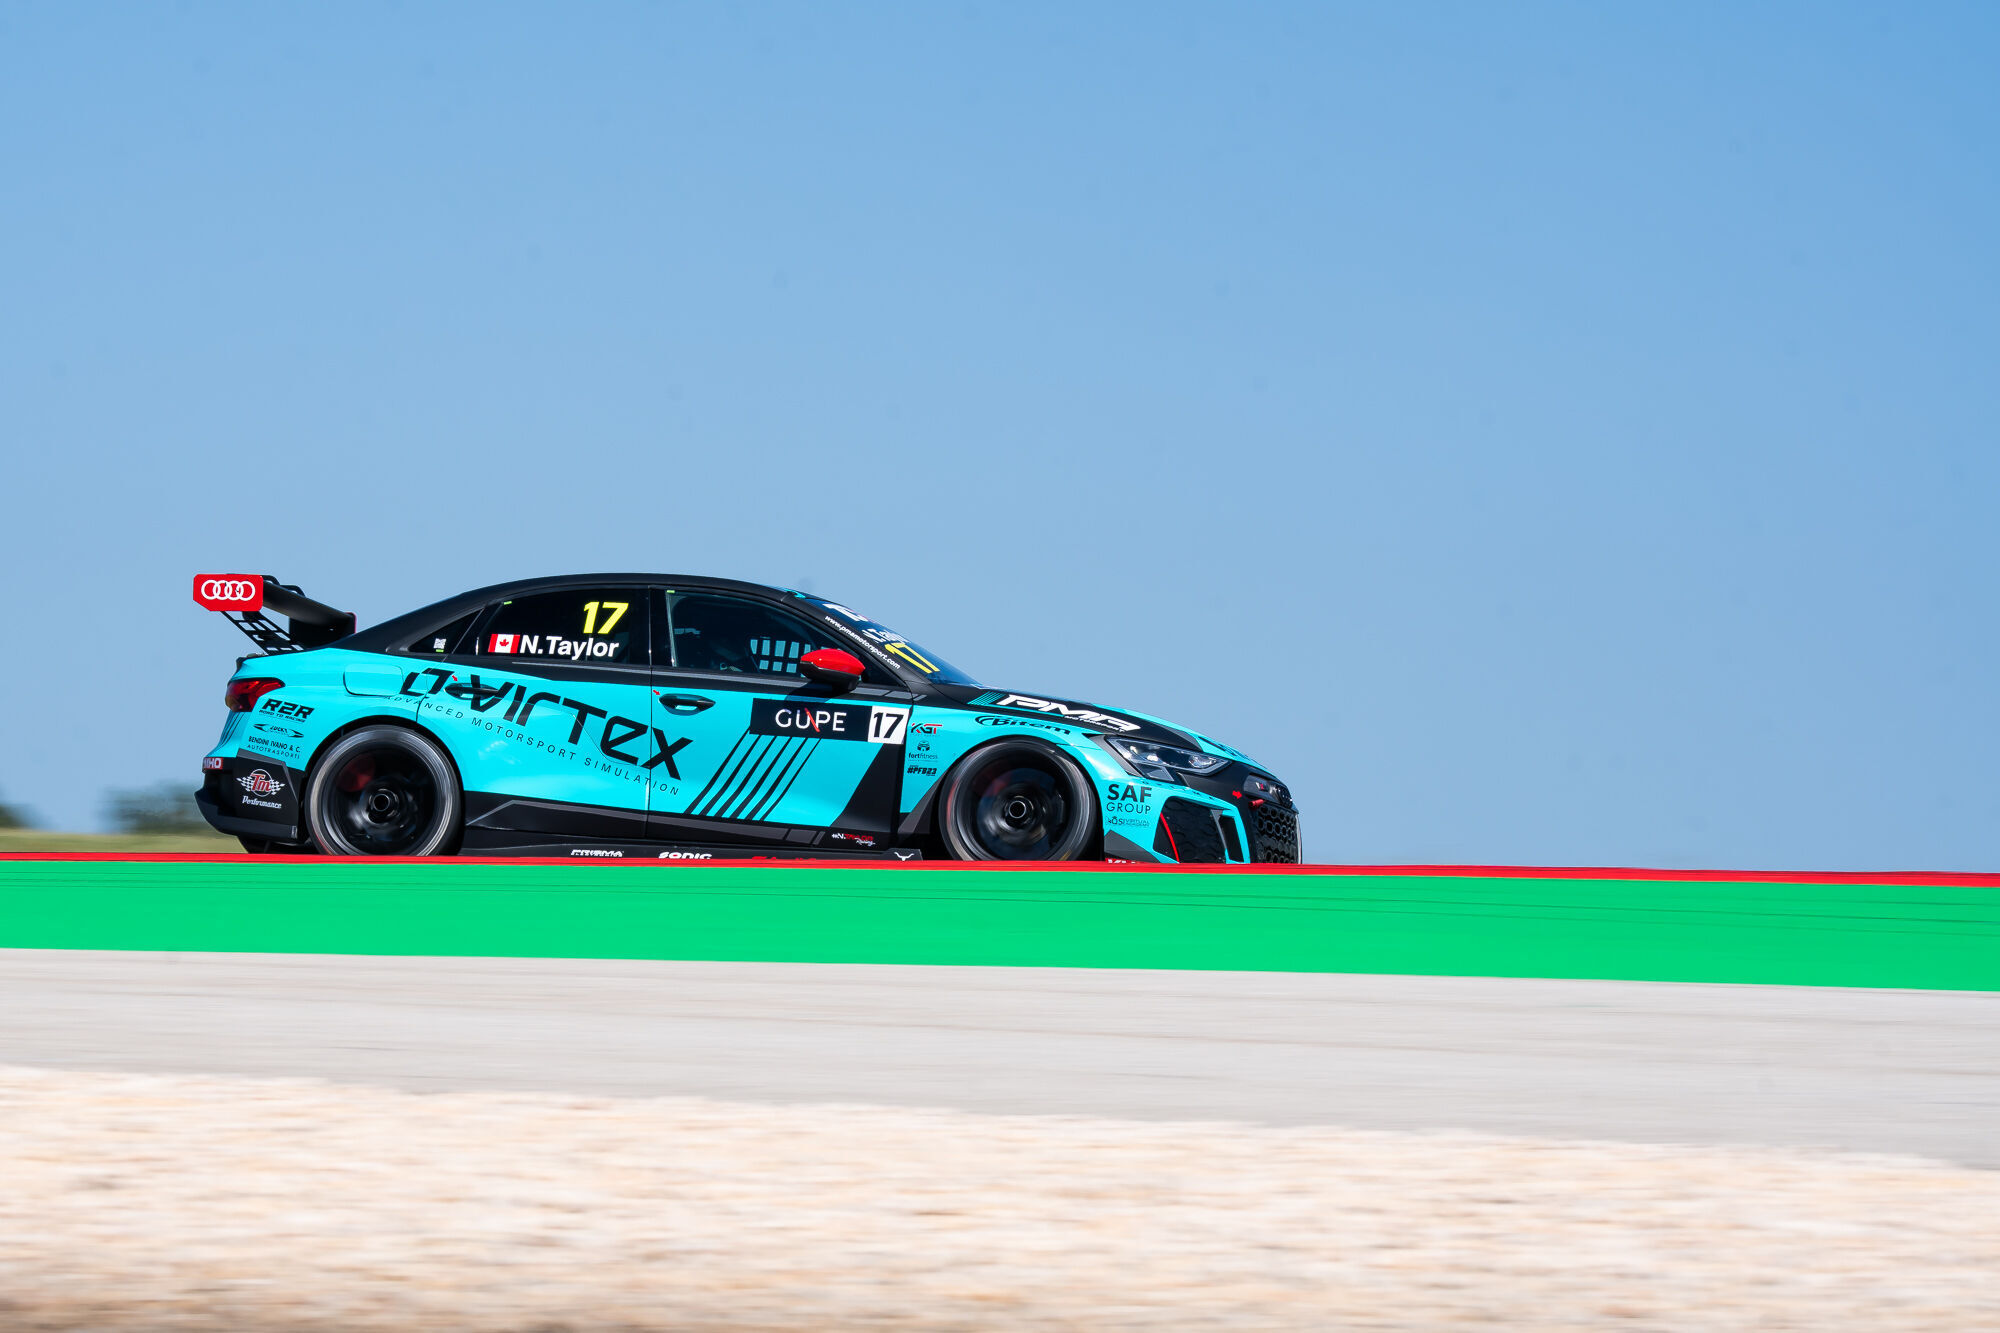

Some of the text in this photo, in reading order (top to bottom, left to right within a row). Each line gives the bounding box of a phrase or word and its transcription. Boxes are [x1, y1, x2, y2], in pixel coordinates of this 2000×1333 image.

[583, 601, 629, 634] 17
[520, 634, 620, 660] N.Taylor
[884, 642, 940, 674] 17
[261, 698, 315, 719] R2R
[873, 712, 904, 739] 17
[247, 744, 300, 759] AUTOTRASPORTI
[270, 740, 288, 750] IVANO
[384, 694, 680, 796] ADVANCED MOTORSPORT SIMULATION
[242, 795, 282, 809] Performance
[1107, 783, 1152, 803] SAF
[1106, 802, 1151, 815] GROUP
